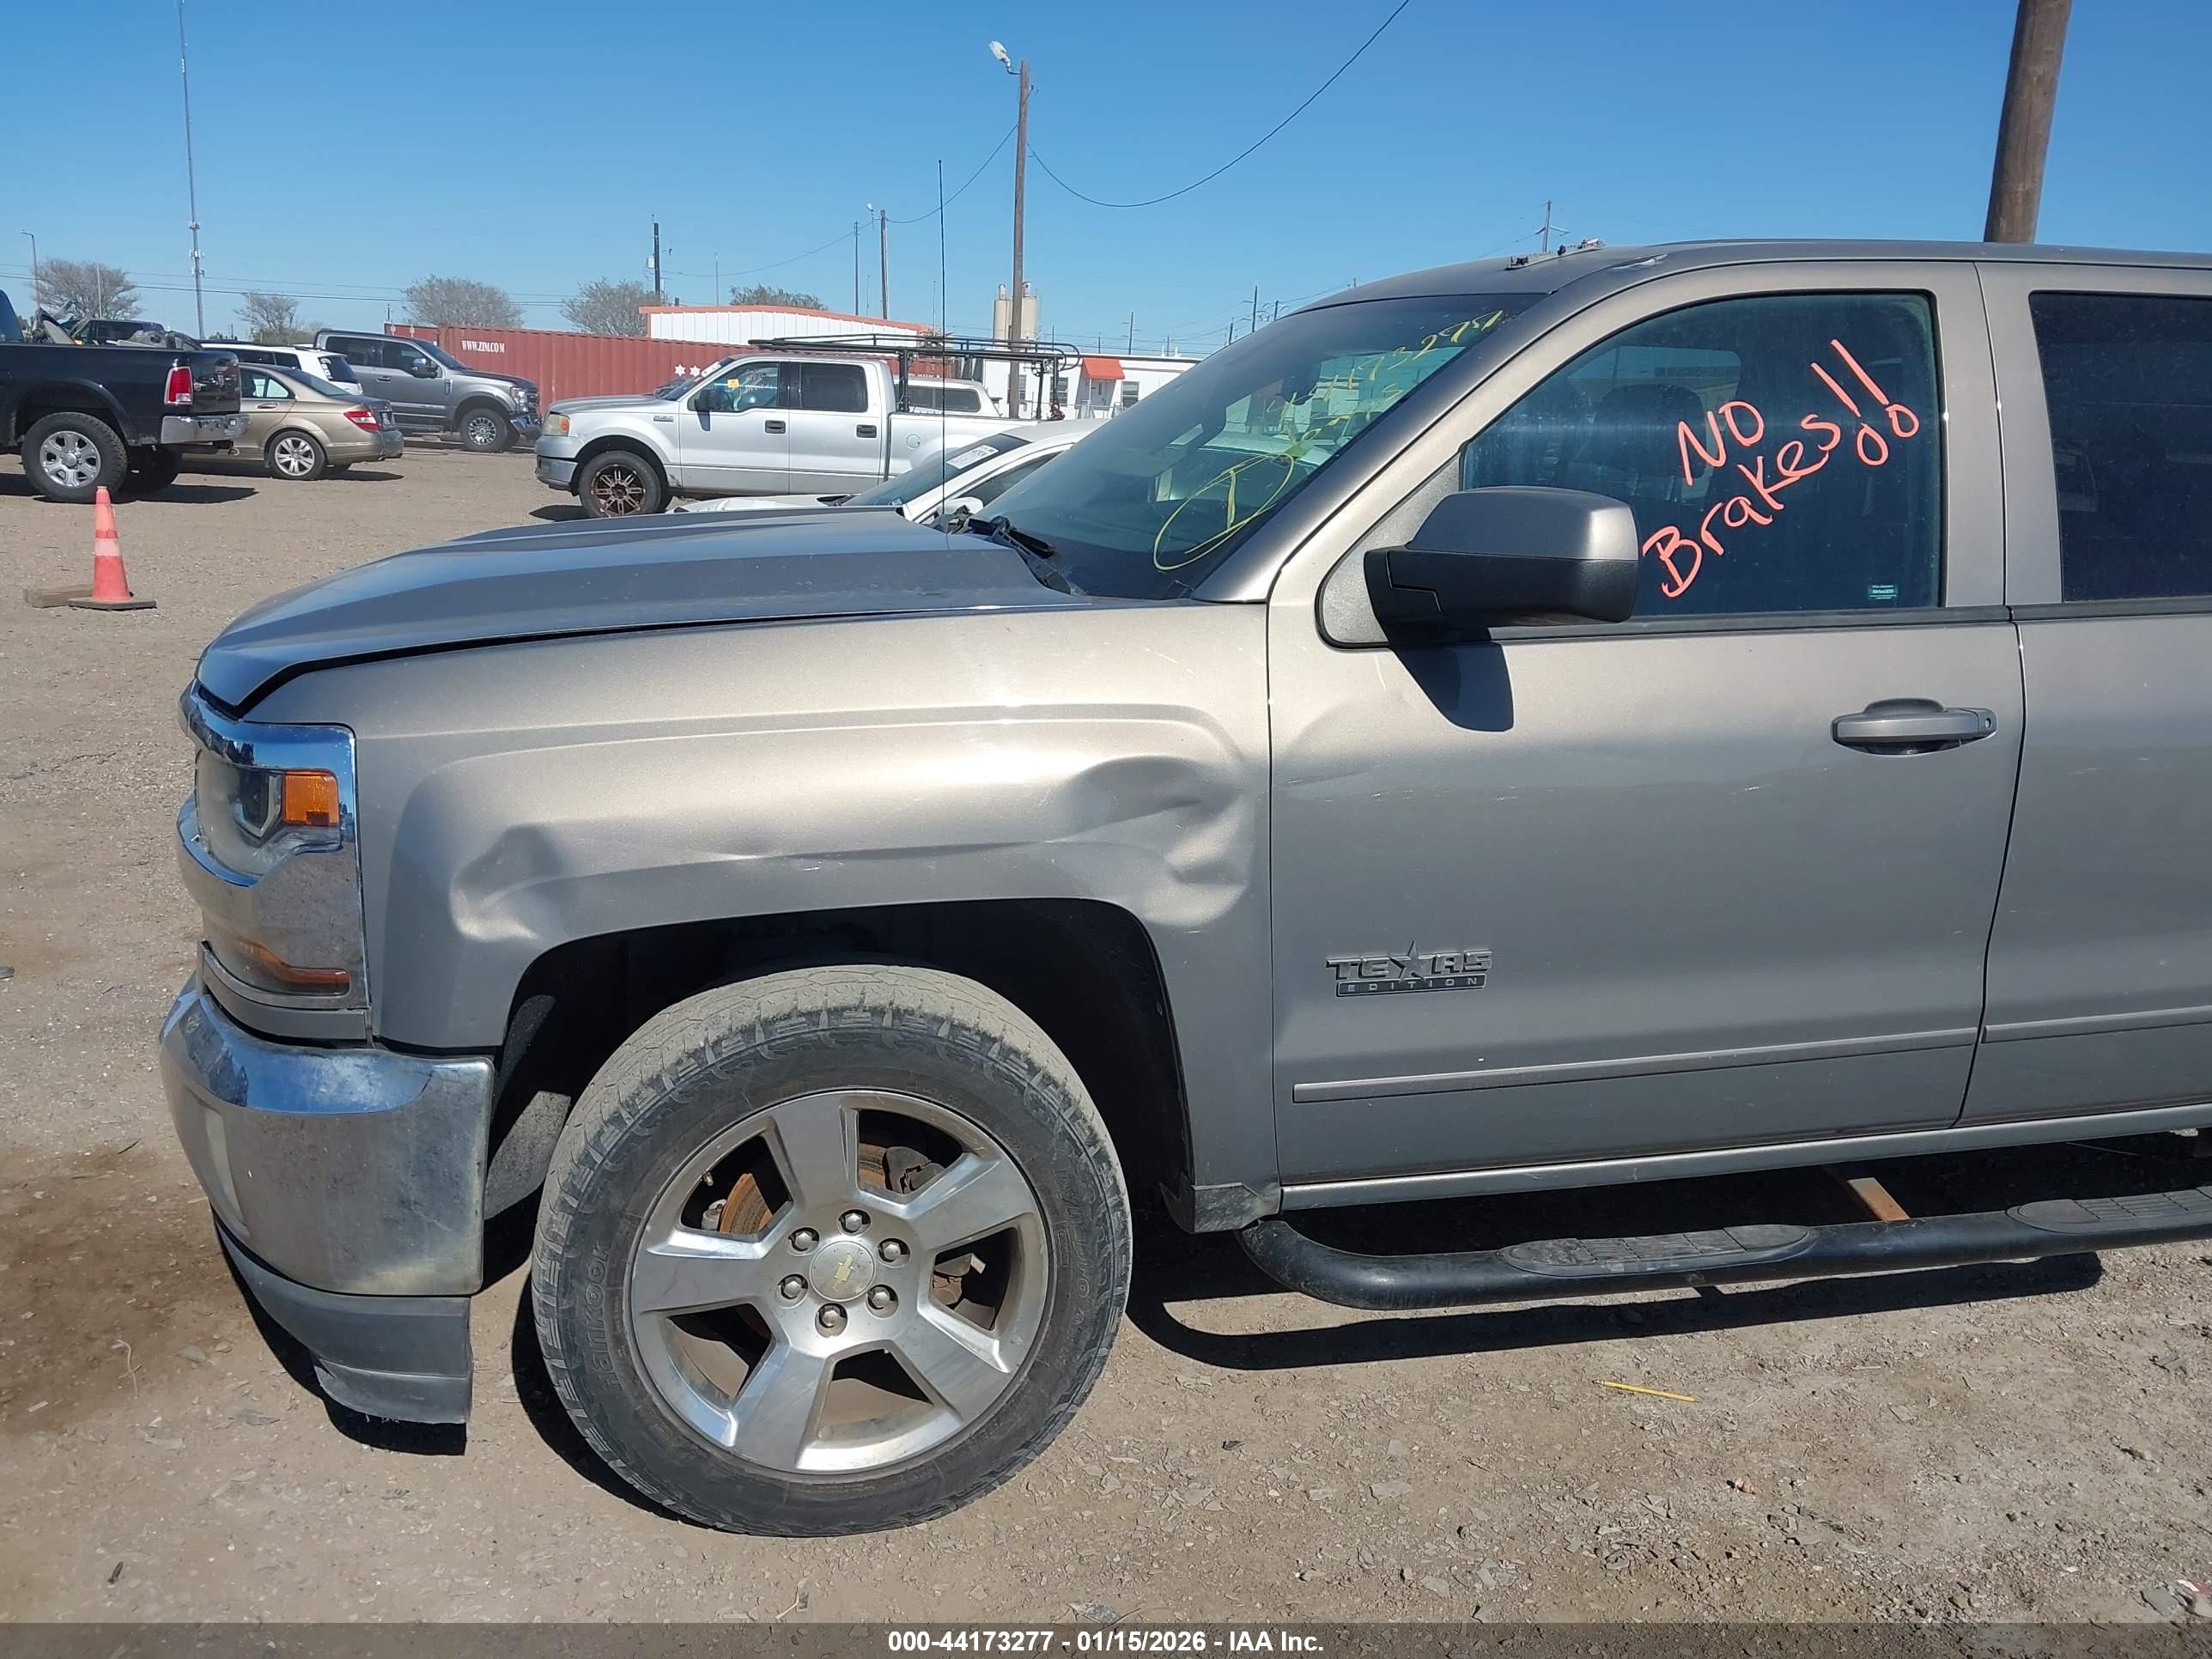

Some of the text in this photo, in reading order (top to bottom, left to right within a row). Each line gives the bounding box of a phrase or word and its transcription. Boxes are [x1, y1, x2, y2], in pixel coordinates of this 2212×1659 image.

[461, 340, 505, 353] WWW.ZIM.COM
[1326, 946, 1492, 981] TEXAS
[1346, 976, 1478, 993] EDITION
